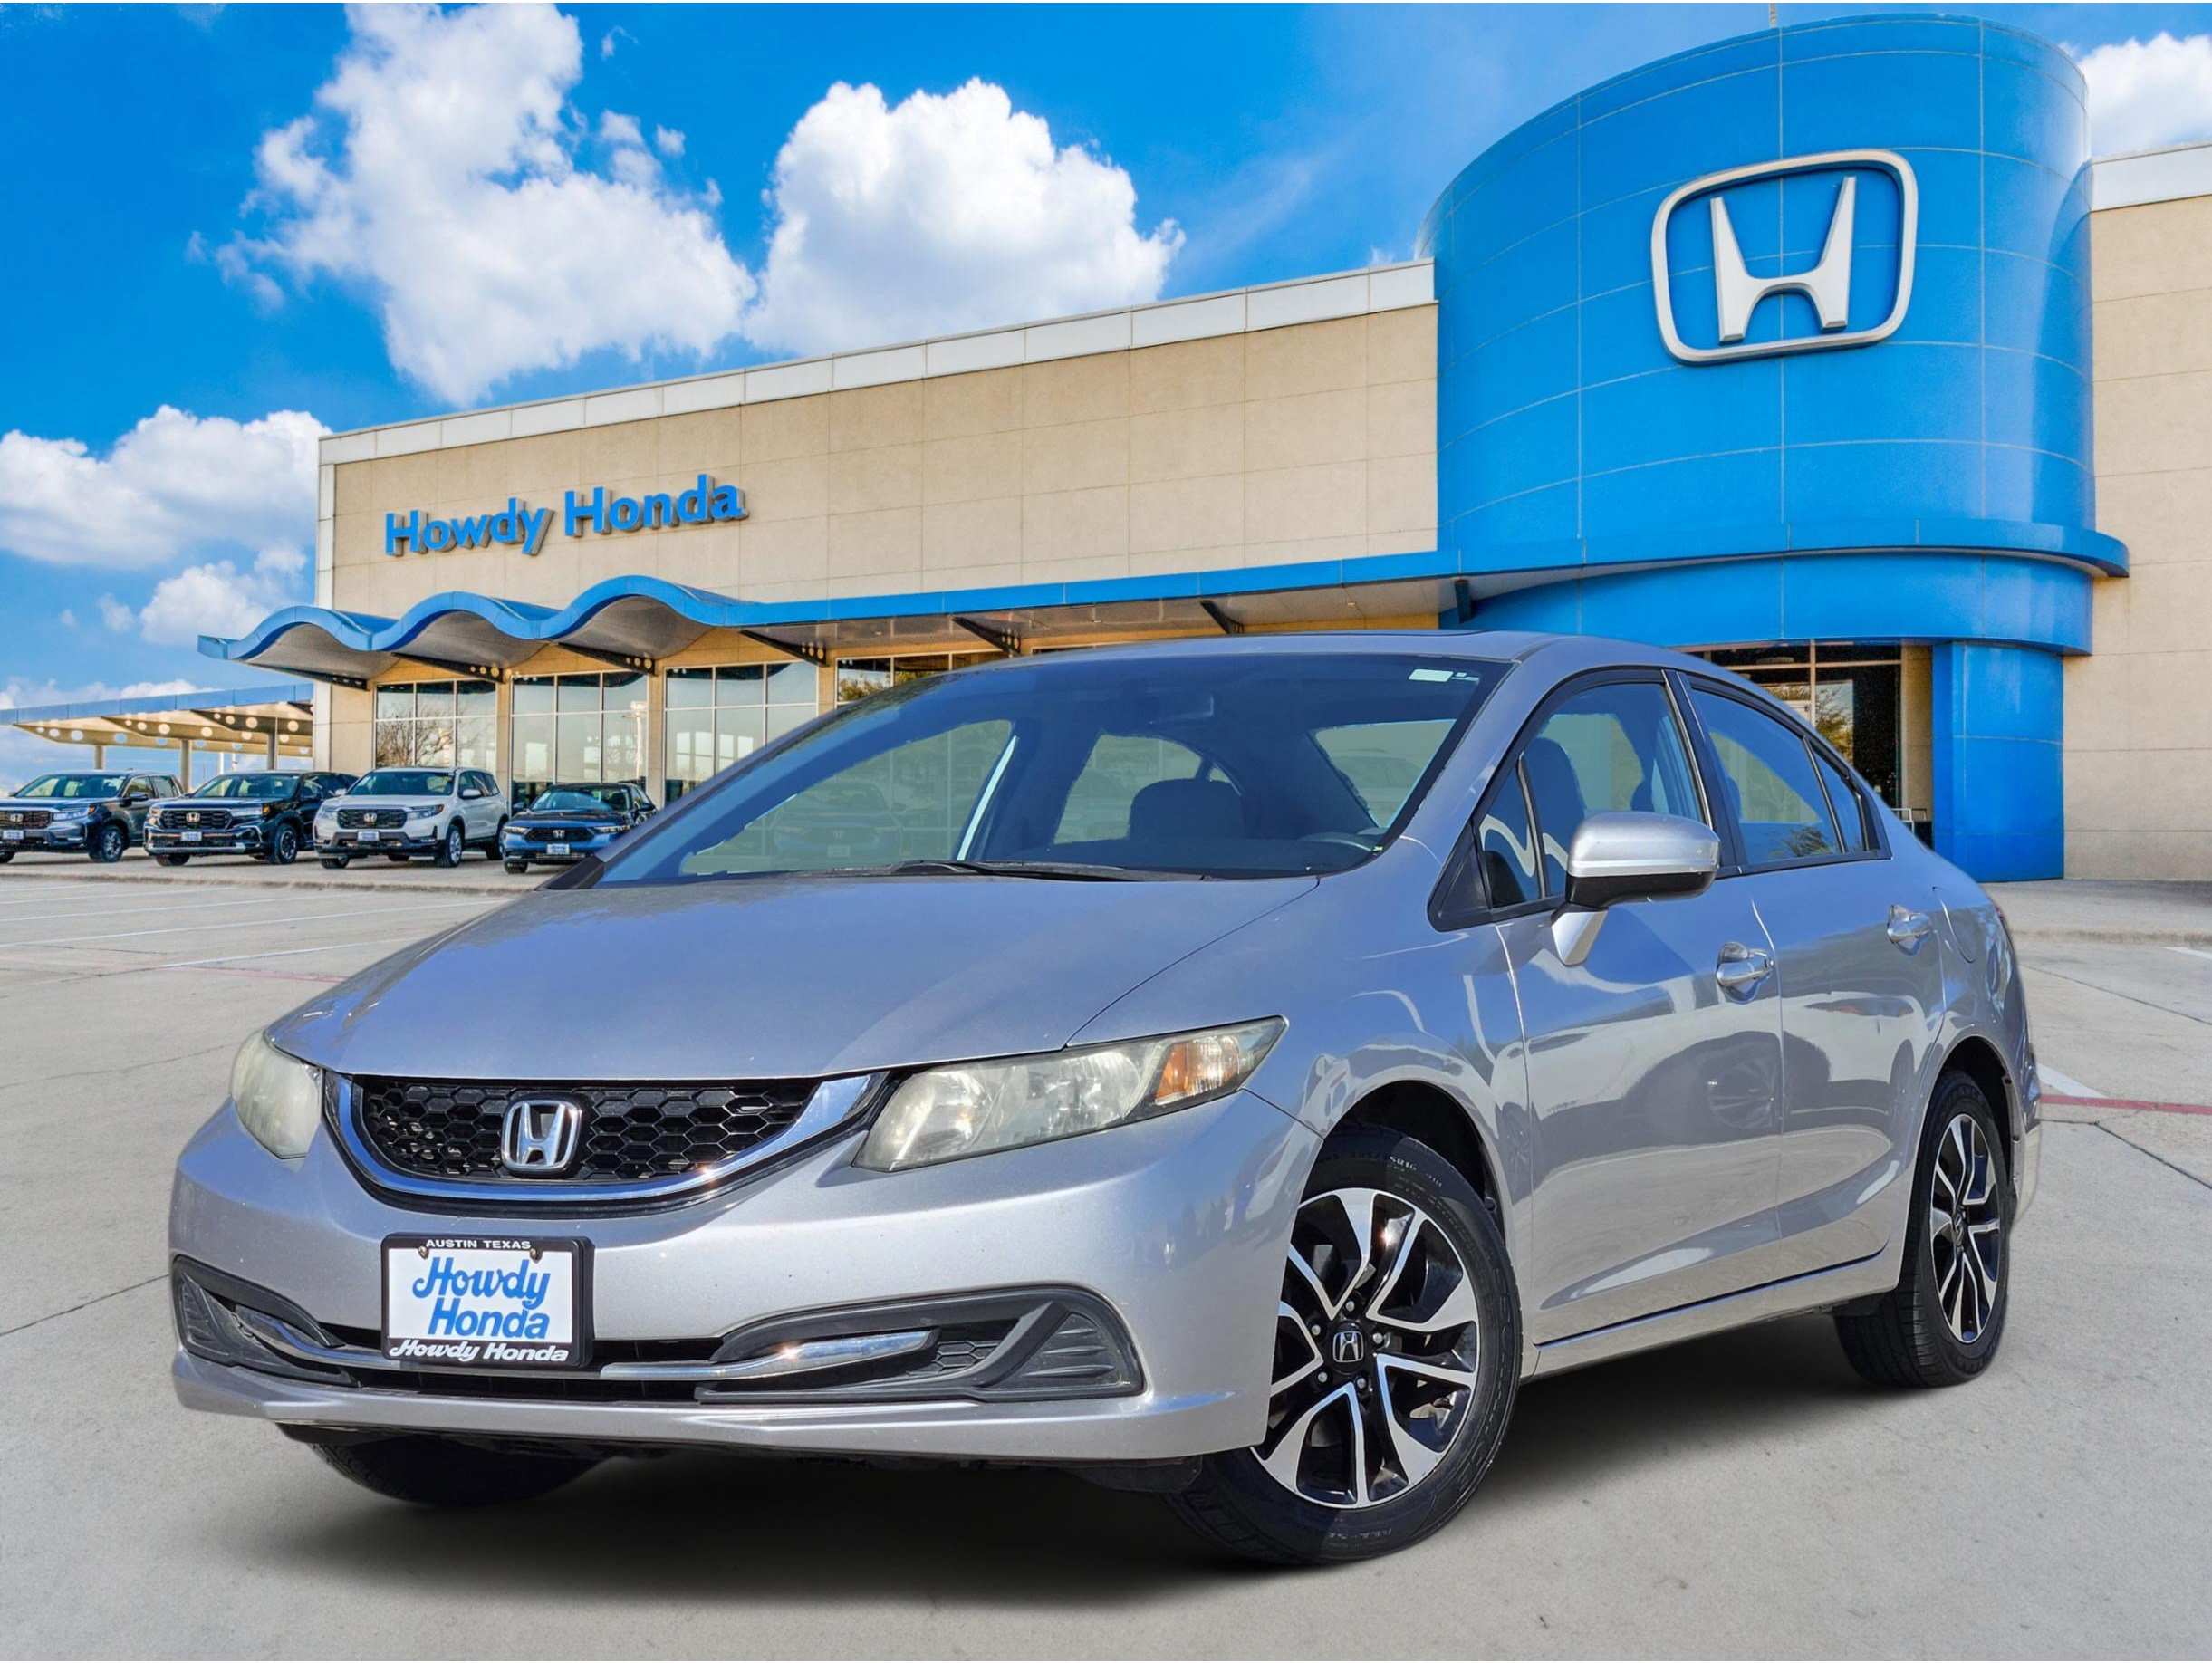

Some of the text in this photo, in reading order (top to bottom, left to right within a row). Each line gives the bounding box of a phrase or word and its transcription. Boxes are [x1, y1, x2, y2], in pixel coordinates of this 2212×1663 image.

[385, 474, 748, 556] Howdy Honda
[426, 1239, 532, 1250] AUSTIN TEXAS
[412, 1257, 551, 1310] Howdy
[428, 1297, 551, 1339] Honda
[389, 1339, 570, 1362] Howdy Honda
